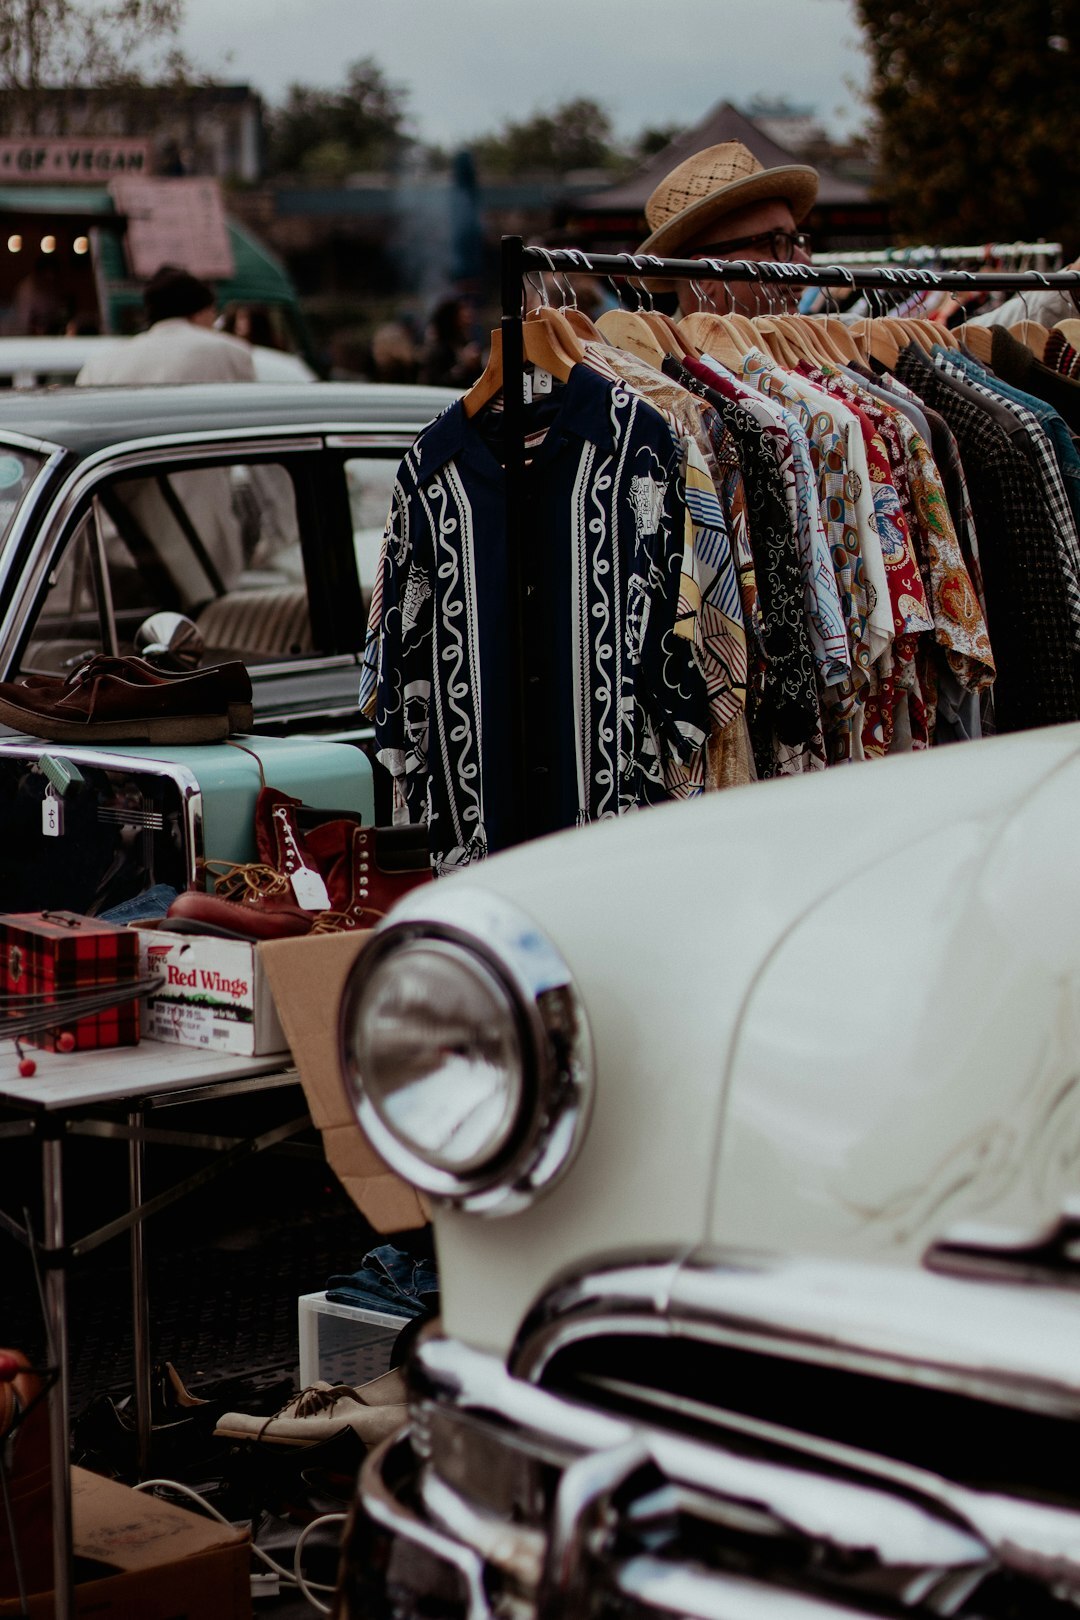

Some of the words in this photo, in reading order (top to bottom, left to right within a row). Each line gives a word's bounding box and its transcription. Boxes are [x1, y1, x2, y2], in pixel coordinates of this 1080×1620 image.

[66, 149, 144, 171] VEGAN
[167, 964, 197, 988] Red
[199, 969, 248, 999] Wings
